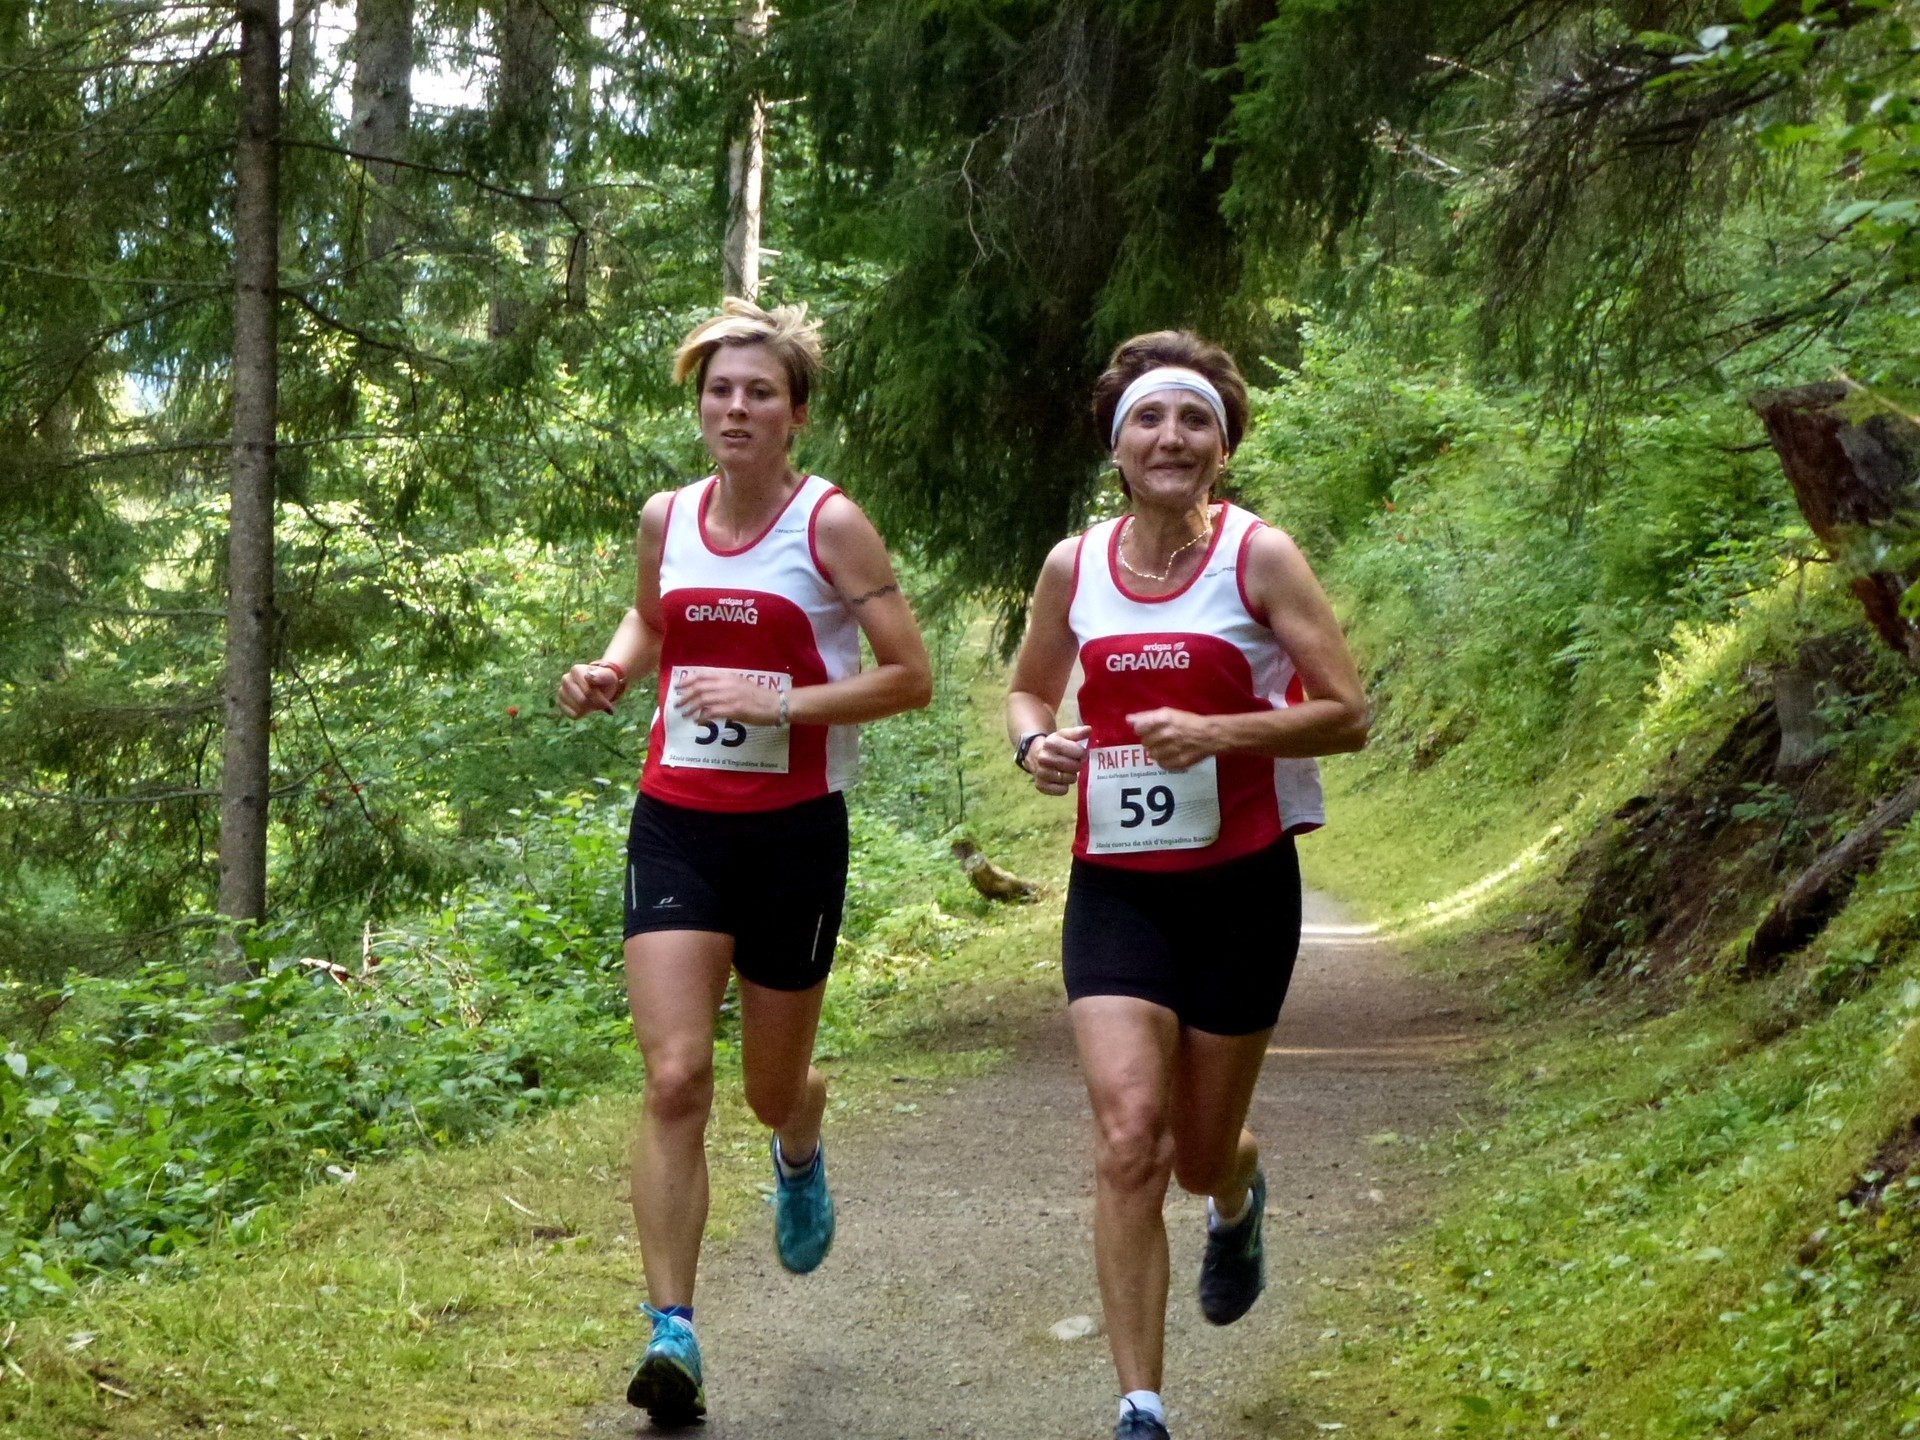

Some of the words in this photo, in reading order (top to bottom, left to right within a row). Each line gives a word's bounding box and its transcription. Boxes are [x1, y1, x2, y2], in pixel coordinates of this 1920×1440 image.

[718, 597, 743, 606] erdgas
[685, 605, 758, 625] GRAVAG
[1143, 643, 1172, 651] erdgas
[1106, 651, 1190, 672] GRAVAG
[1120, 785, 1175, 828] 59
